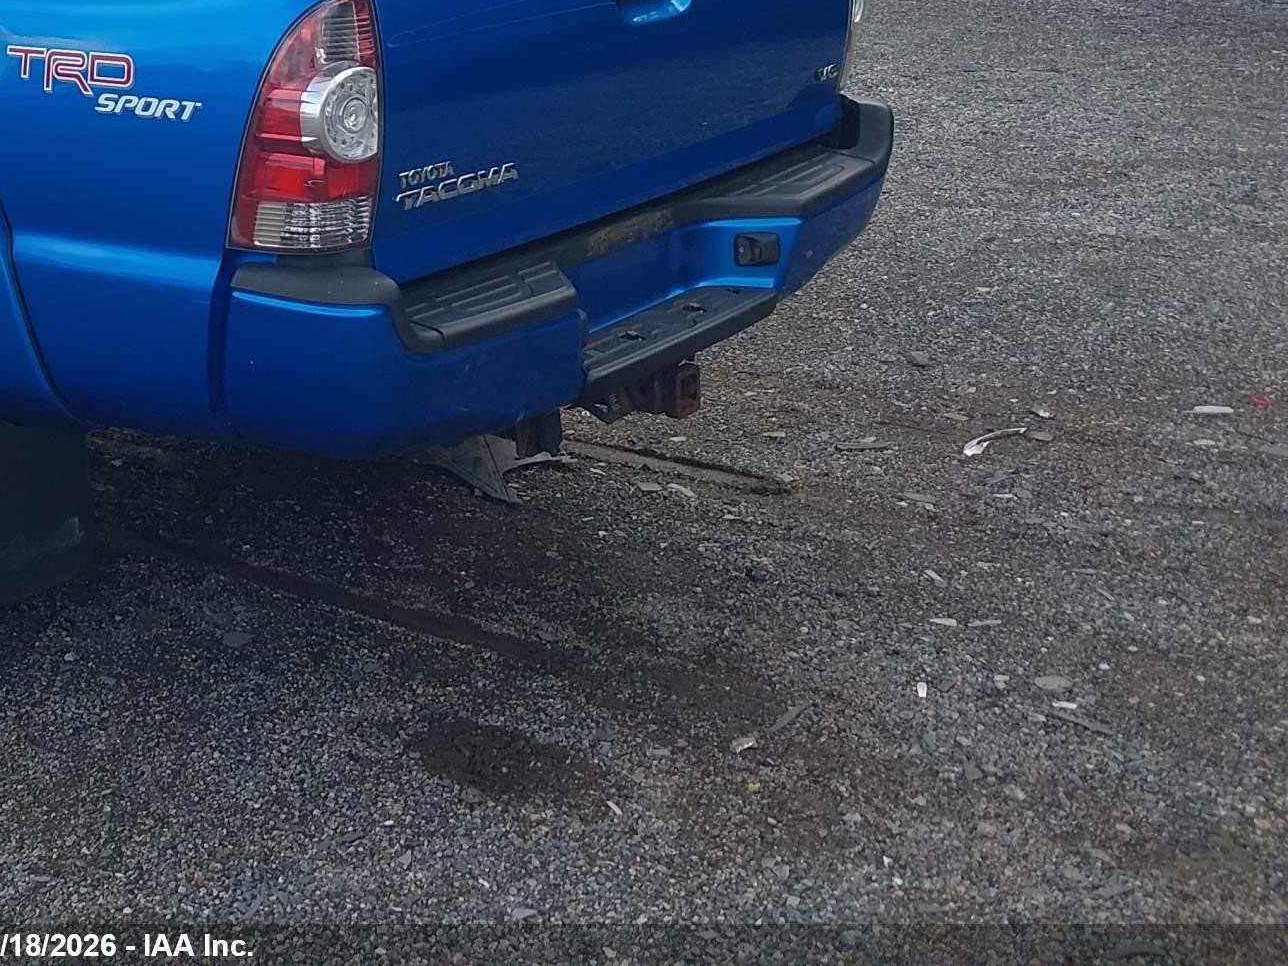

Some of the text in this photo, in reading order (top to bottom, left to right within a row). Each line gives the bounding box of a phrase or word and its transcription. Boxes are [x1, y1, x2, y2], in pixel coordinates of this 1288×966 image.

[7, 45, 134, 96] TRD
[94, 92, 203, 122] SPORT
[394, 162, 519, 210] TACOMA
[398, 160, 455, 188] TOYOTA
